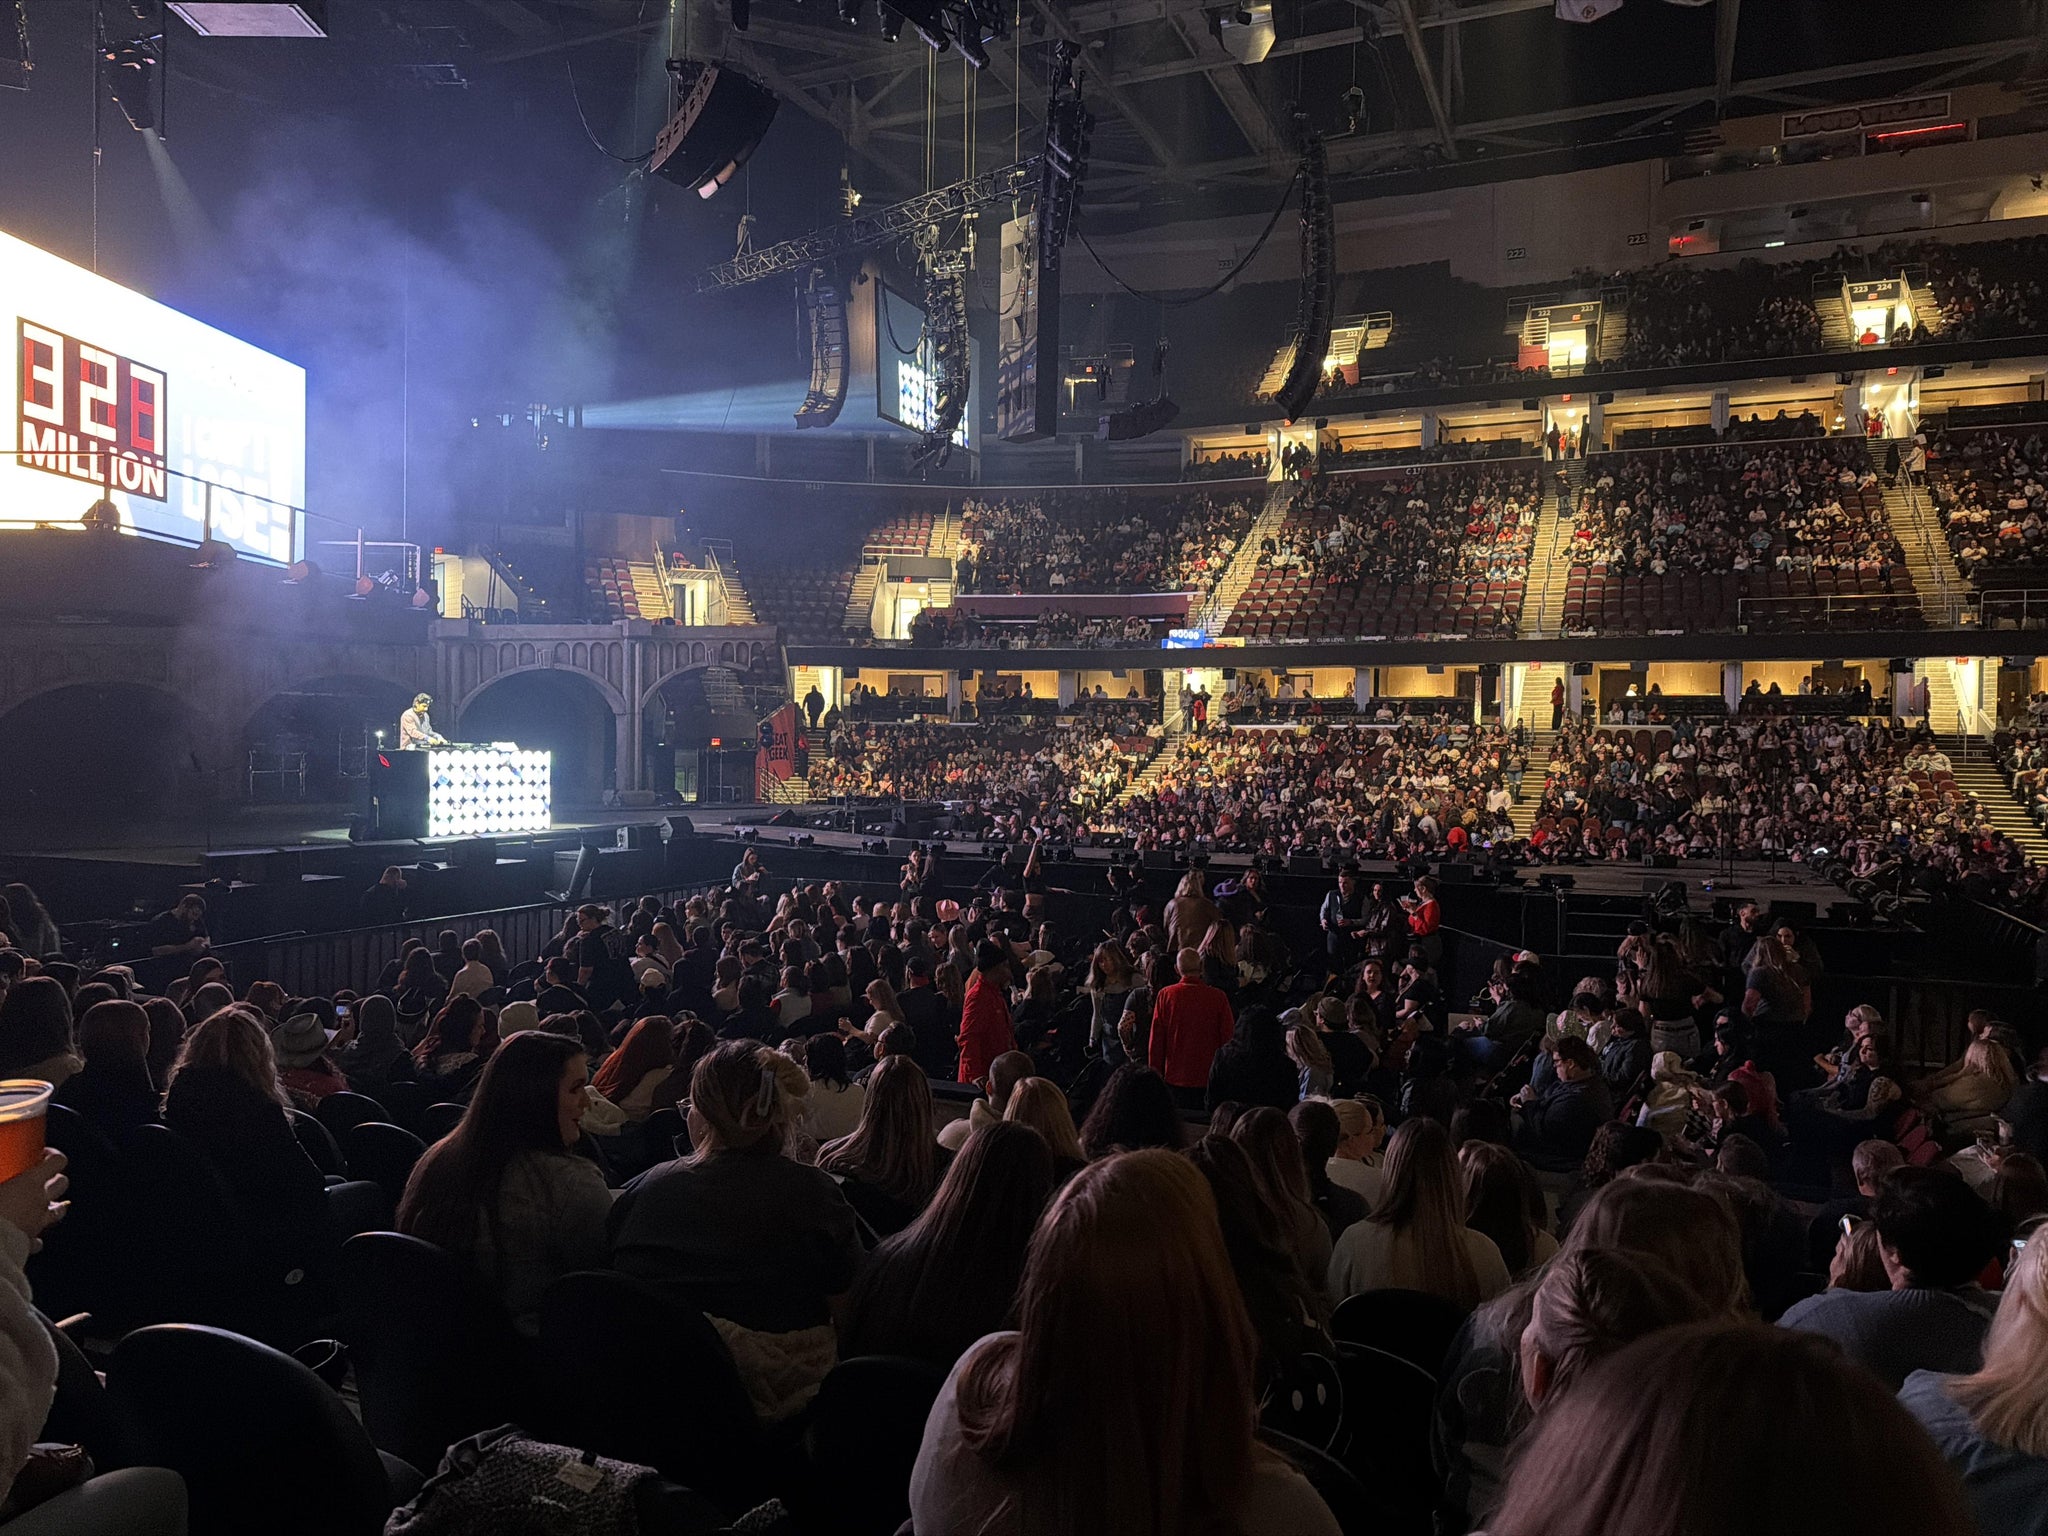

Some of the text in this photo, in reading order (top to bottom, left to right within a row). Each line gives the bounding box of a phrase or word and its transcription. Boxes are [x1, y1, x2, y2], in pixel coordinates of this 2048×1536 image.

[1507, 249, 1524, 258] 222
[1853, 283, 1892, 293] 223 224
[22, 421, 165, 498] MILLION
[773, 733, 788, 745] EAT
[769, 746, 789, 760] GEEK
